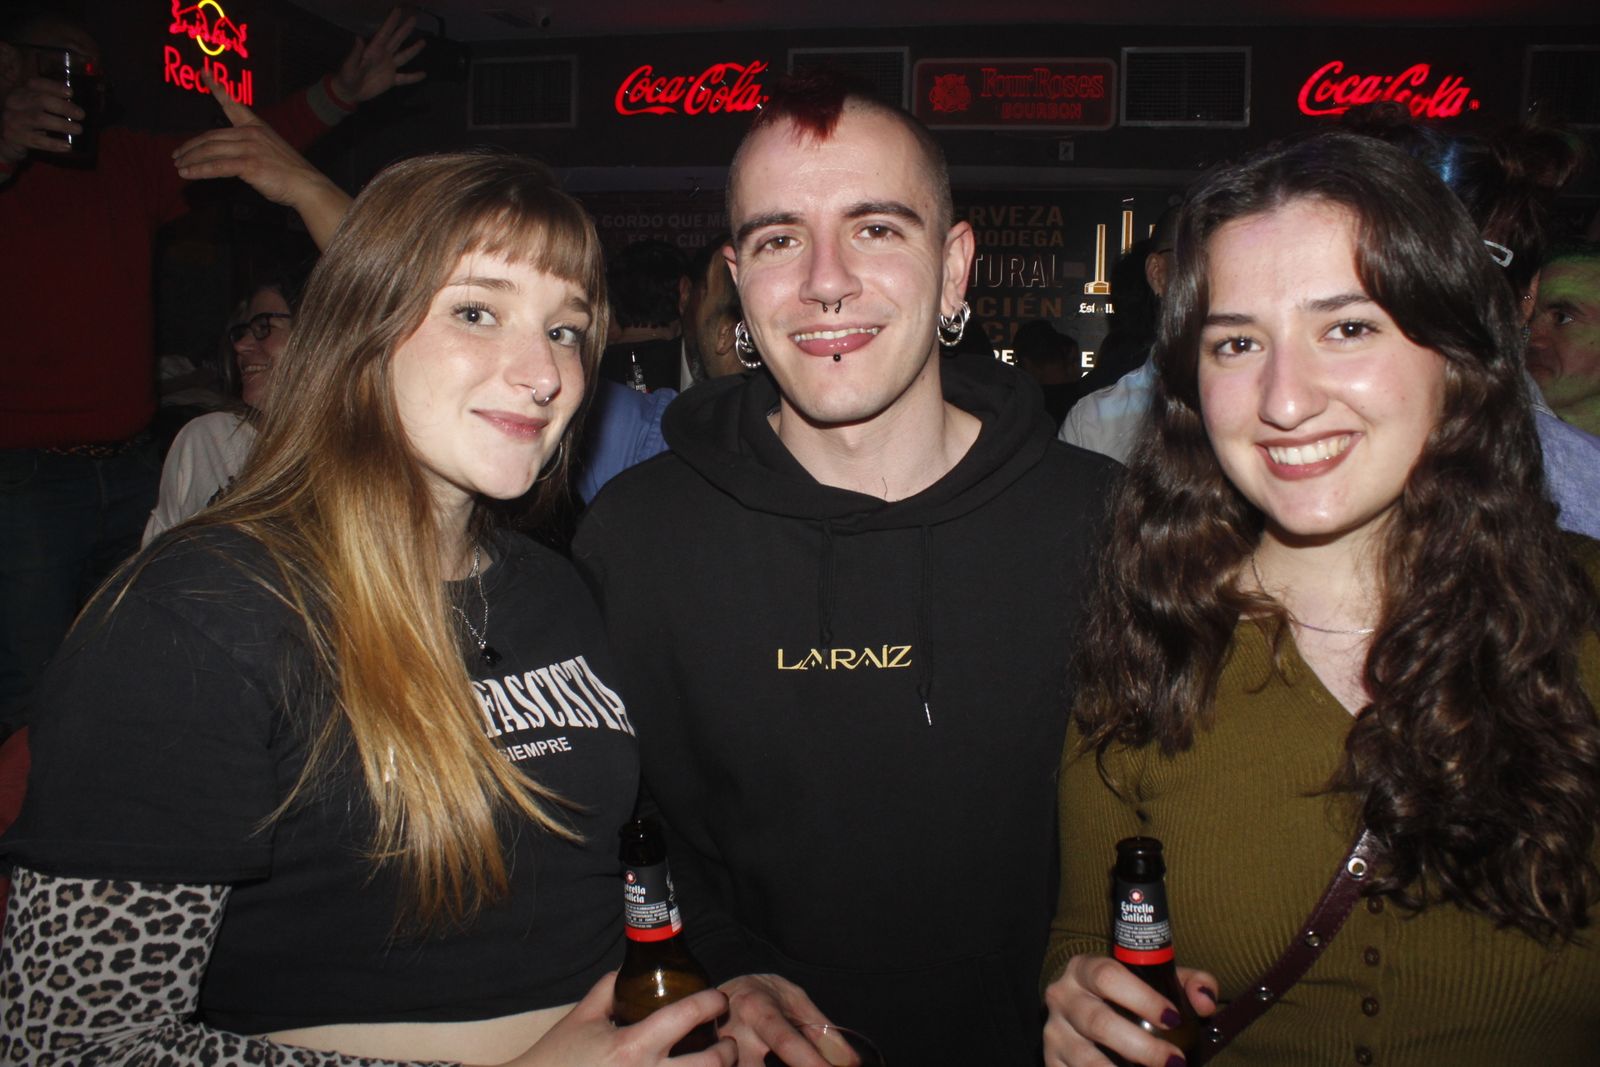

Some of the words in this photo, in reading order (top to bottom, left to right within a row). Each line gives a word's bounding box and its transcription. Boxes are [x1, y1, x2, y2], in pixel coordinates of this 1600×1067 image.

[163, 45, 211, 94] Red
[980, 67, 1032, 97] Four
[1033, 67, 1105, 100] Roses
[1002, 102, 1082, 120] BOURBON
[602, 215, 663, 228] GORDO
[668, 215, 704, 228] QUE
[970, 253, 1064, 288] TURAL
[976, 292, 1062, 318] CIÉN
[1120, 901, 1154, 913] Estrella
[1121, 911, 1153, 923] Galicia
